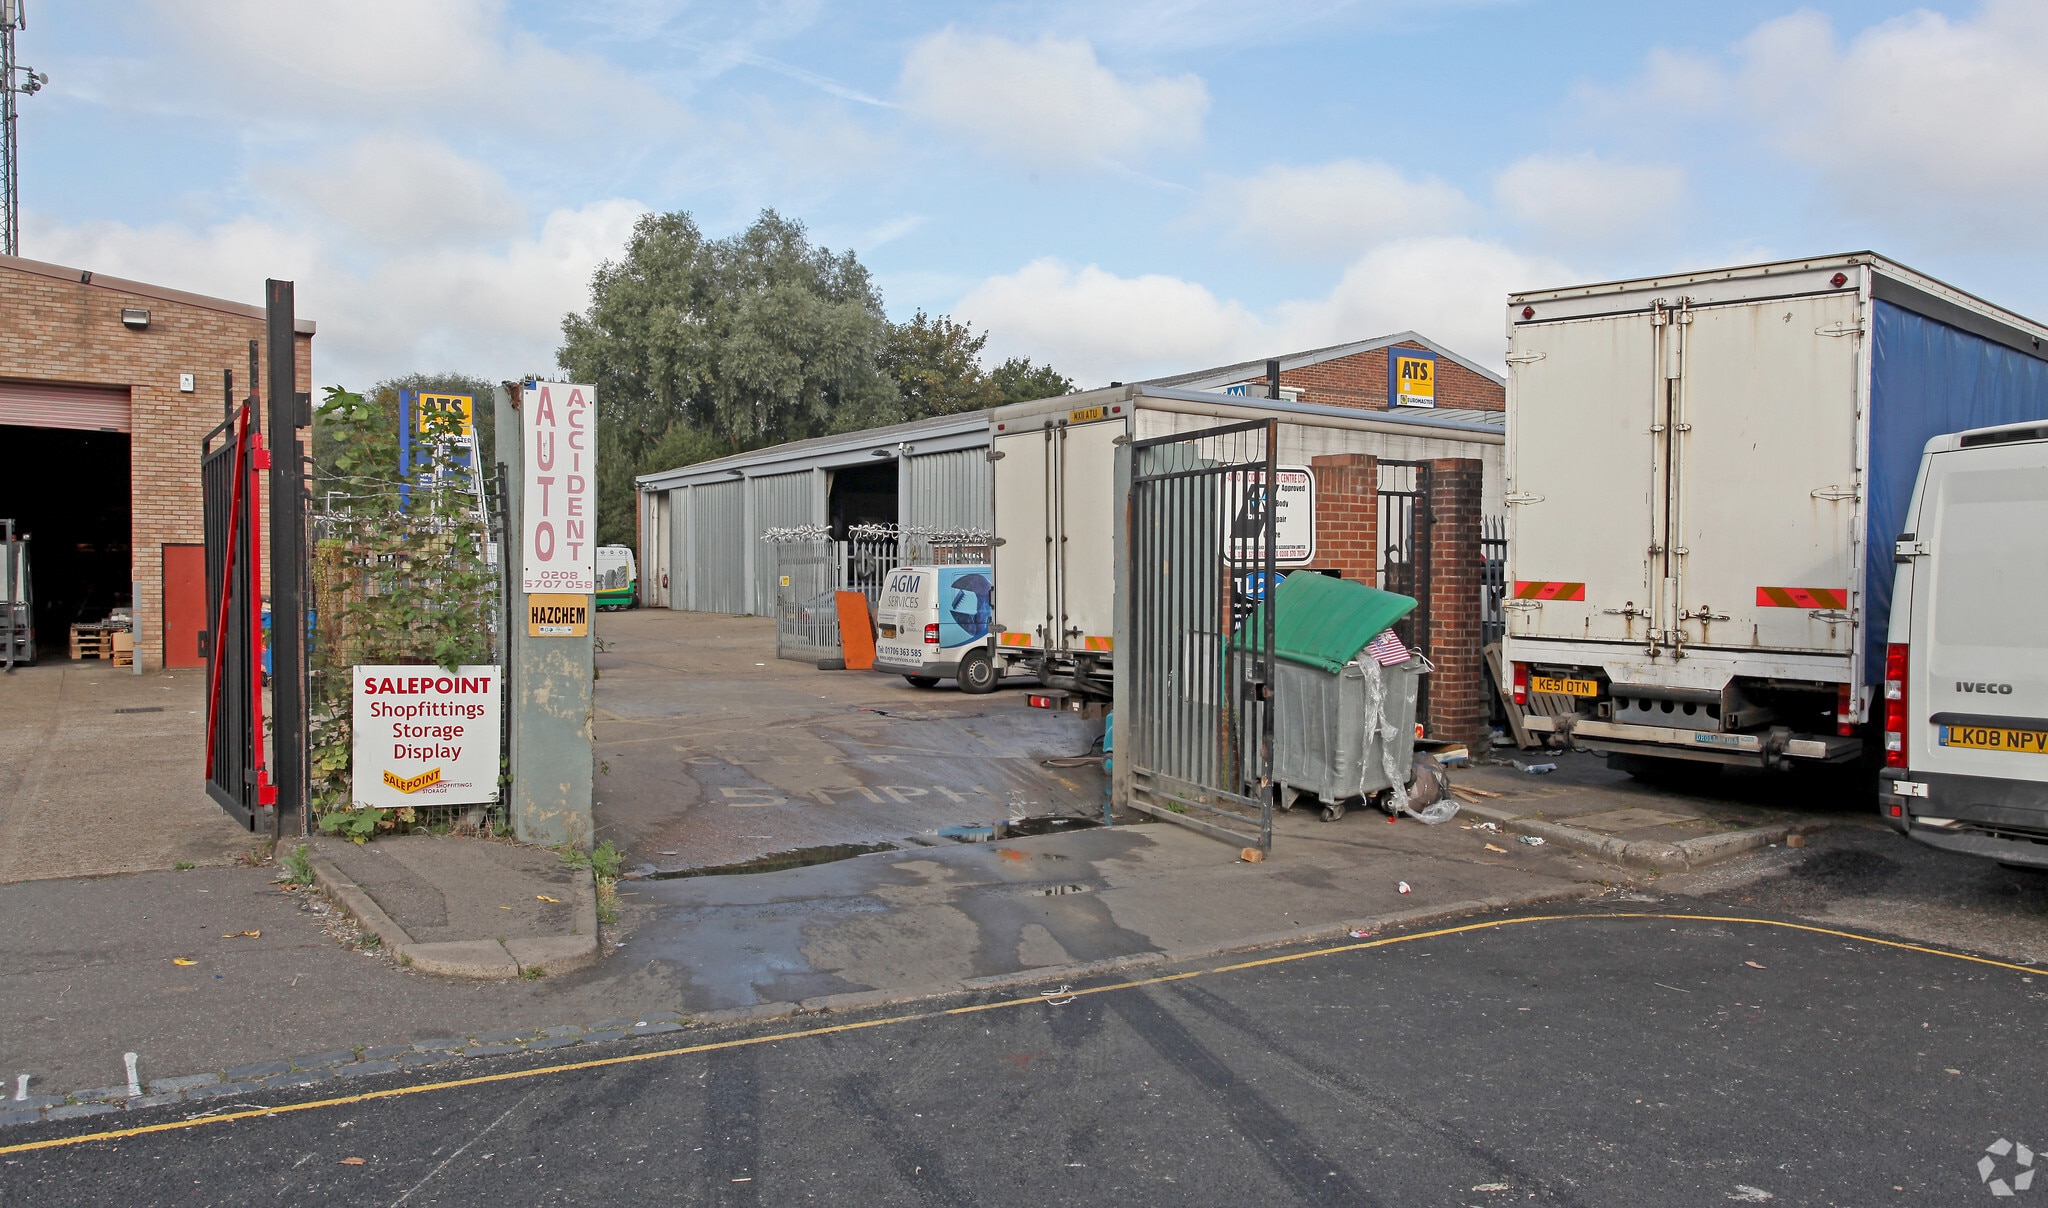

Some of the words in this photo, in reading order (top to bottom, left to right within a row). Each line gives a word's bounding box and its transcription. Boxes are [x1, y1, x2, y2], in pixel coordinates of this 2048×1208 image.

[1402, 361, 1428, 381] ATS
[1086, 408, 1098, 419] ATU
[535, 386, 556, 562] AUTO
[566, 388, 587, 561] ACCIDENT
[1281, 484, 1306, 492] Approved
[524, 580, 561, 588] 5707
[566, 580, 593, 589] 058
[541, 571, 578, 580] 0208
[890, 575, 920, 593] AGM
[888, 595, 919, 608] SERVICES
[531, 606, 586, 624] HAZCHEM
[364, 677, 492, 694] SALEPOINT
[1538, 679, 1564, 692] KE51
[1566, 680, 1590, 693] OTN
[1956, 681, 2013, 695] IVECO
[370, 701, 485, 720] Shopfittings
[393, 722, 464, 740] Storage
[1949, 727, 2001, 746] LK08
[2006, 731, 2048, 751] NPV
[394, 743, 462, 762] Display
[383, 769, 440, 791] SALEPOINT
[718, 786, 787, 807] 5
